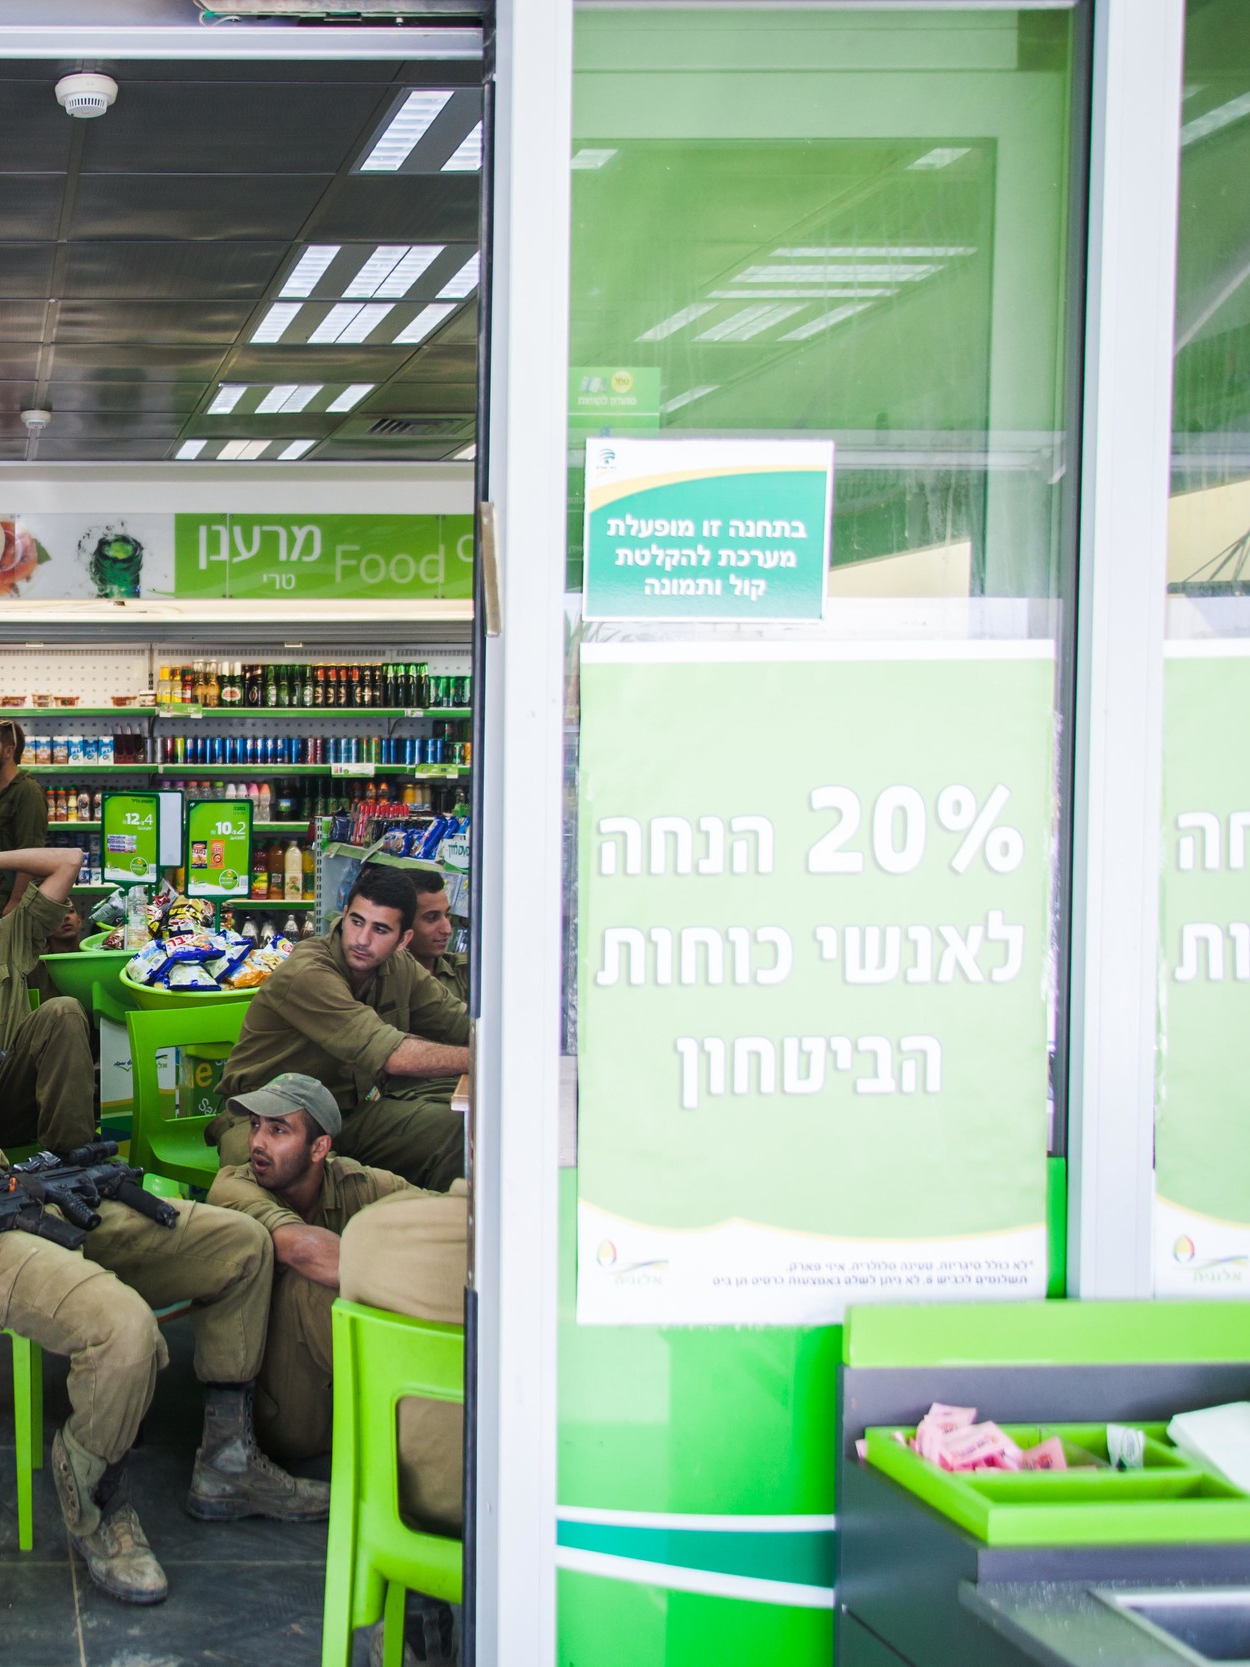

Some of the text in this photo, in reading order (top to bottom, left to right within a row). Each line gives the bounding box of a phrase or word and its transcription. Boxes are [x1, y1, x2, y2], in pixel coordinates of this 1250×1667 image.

[607, 513, 807, 538] בתחנה זו מופעלת
[199, 525, 322, 570] מרענן
[335, 544, 445, 584] Food
[615, 544, 797, 571] מערכת להקלטת
[263, 573, 296, 590] טרי
[644, 574, 767, 601] קול ותמונה
[597, 783, 1026, 875] 20% הנחה
[595, 909, 1026, 987] לאנשי כוחות
[675, 1034, 943, 1110] הביטחון
[900, 1261, 934, 1271] טעינה
[986, 1259, 1010, 1271] כולל
[735, 1276, 748, 1288] תן
[751, 1275, 784, 1286] כרטיס
[788, 1275, 841, 1286] באמצעות
[845, 1274, 876, 1286] לשלם
[880, 1275, 902, 1288] ניתן
[906, 1274, 920, 1286] לא
[937, 1273, 972, 1285] לכביש
[977, 1274, 1028, 1285] תשלומים
